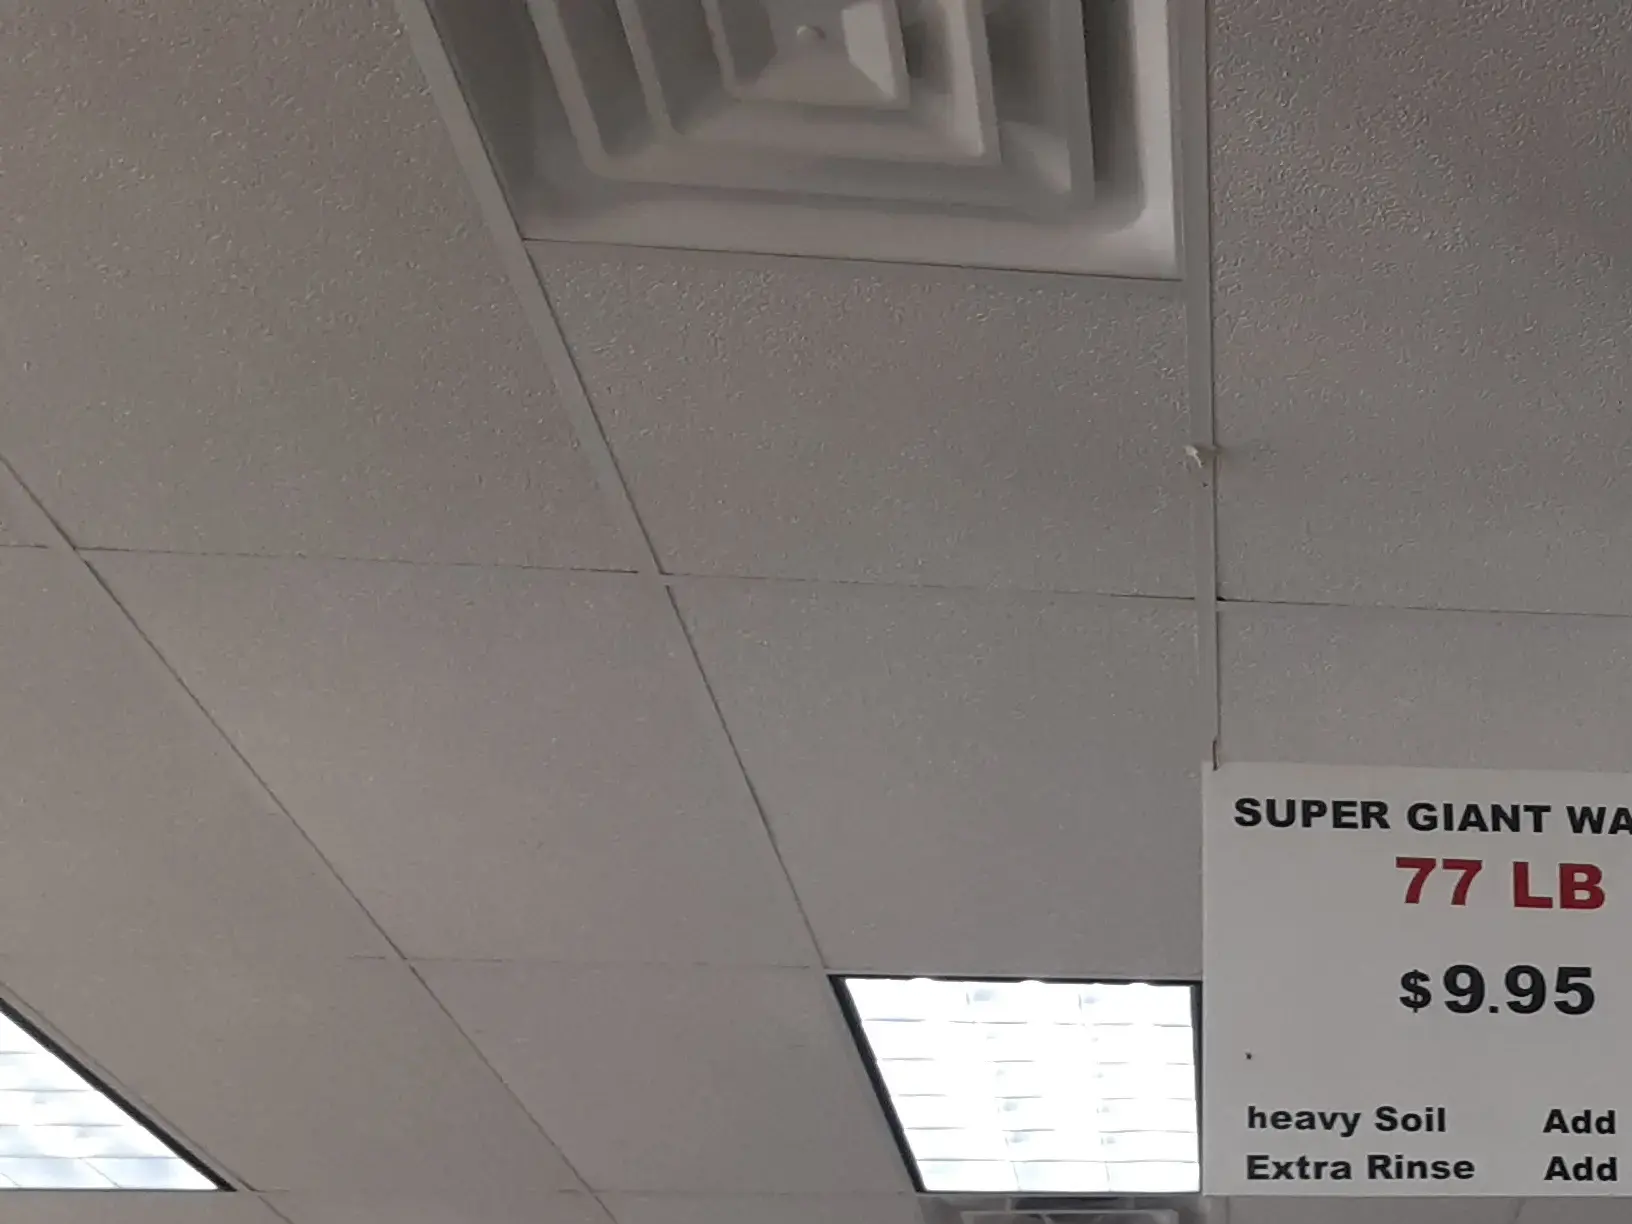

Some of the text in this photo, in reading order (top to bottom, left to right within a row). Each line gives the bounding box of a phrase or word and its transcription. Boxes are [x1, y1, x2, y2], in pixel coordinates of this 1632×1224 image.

[1234, 798, 1390, 829] SUPER
[1407, 802, 1551, 833] GIANT
[1395, 856, 1606, 910] 77 LB
[1399, 964, 1595, 1015] $9.95
[1247, 1106, 1361, 1137] heavy
[1374, 1107, 1446, 1133] Soil
[1543, 1109, 1617, 1135] Add
[1247, 1155, 1352, 1181] Extra
[1367, 1155, 1475, 1181] Rinse
[1544, 1156, 1618, 1182] Add
